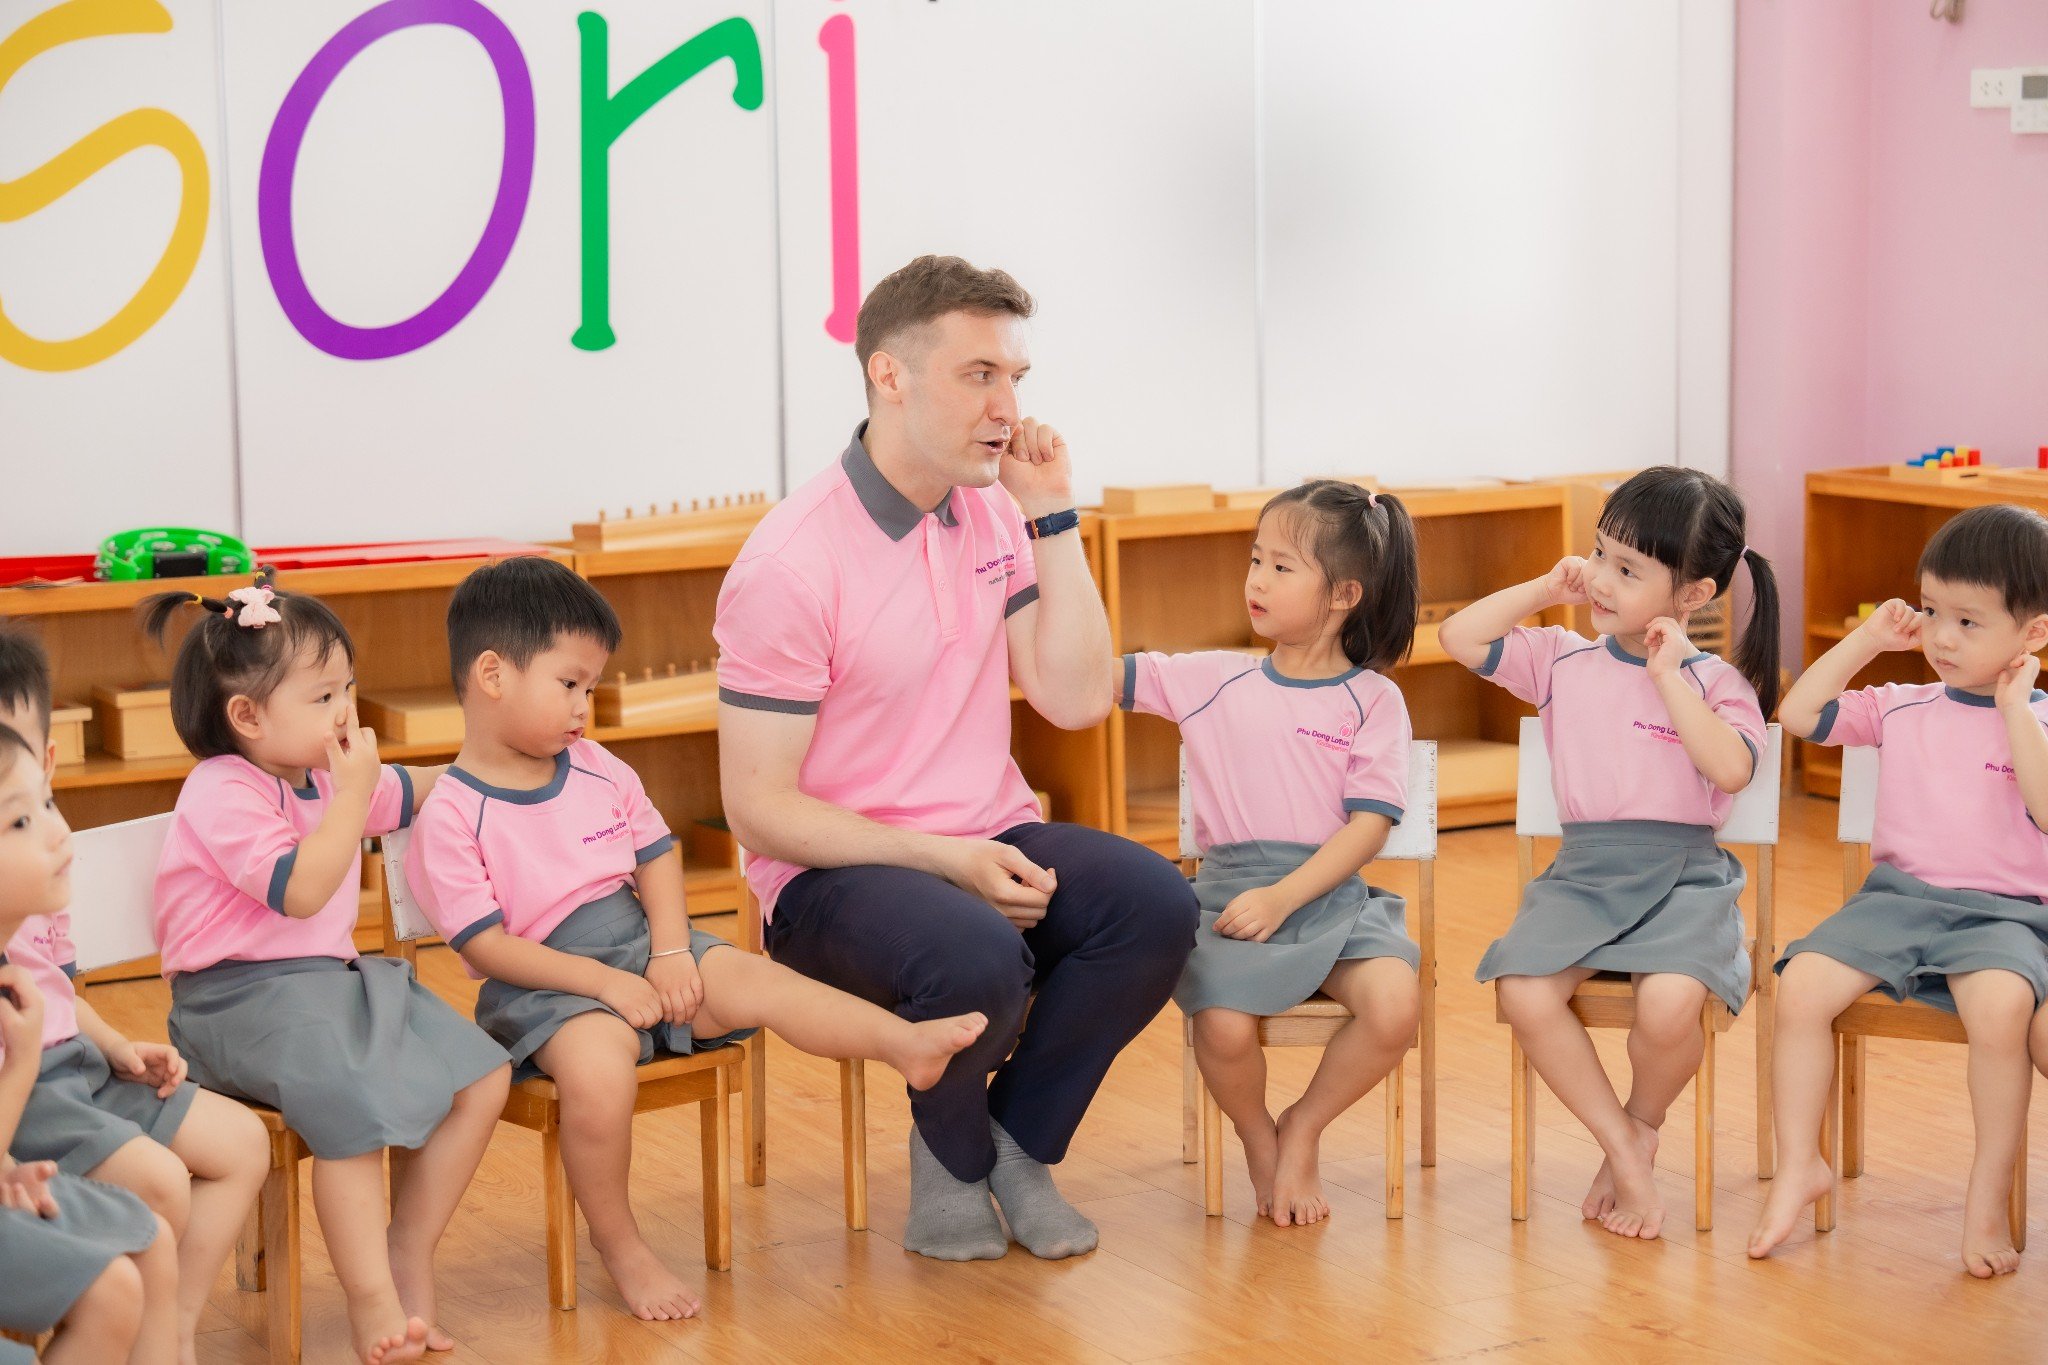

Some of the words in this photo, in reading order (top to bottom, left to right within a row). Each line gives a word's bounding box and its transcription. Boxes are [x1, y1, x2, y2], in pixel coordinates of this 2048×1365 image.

[1633, 721, 1646, 729] Phu
[1648, 724, 1666, 733] Dong
[1311, 730, 1331, 742] Dong
[1330, 736, 1350, 747] Lotus
[1985, 763, 2000, 772] Phu
[2001, 765, 2015, 774] Don
[582, 836, 596, 844] Phu
[596, 828, 614, 838] Dong
[613, 821, 627, 831] Lotus
